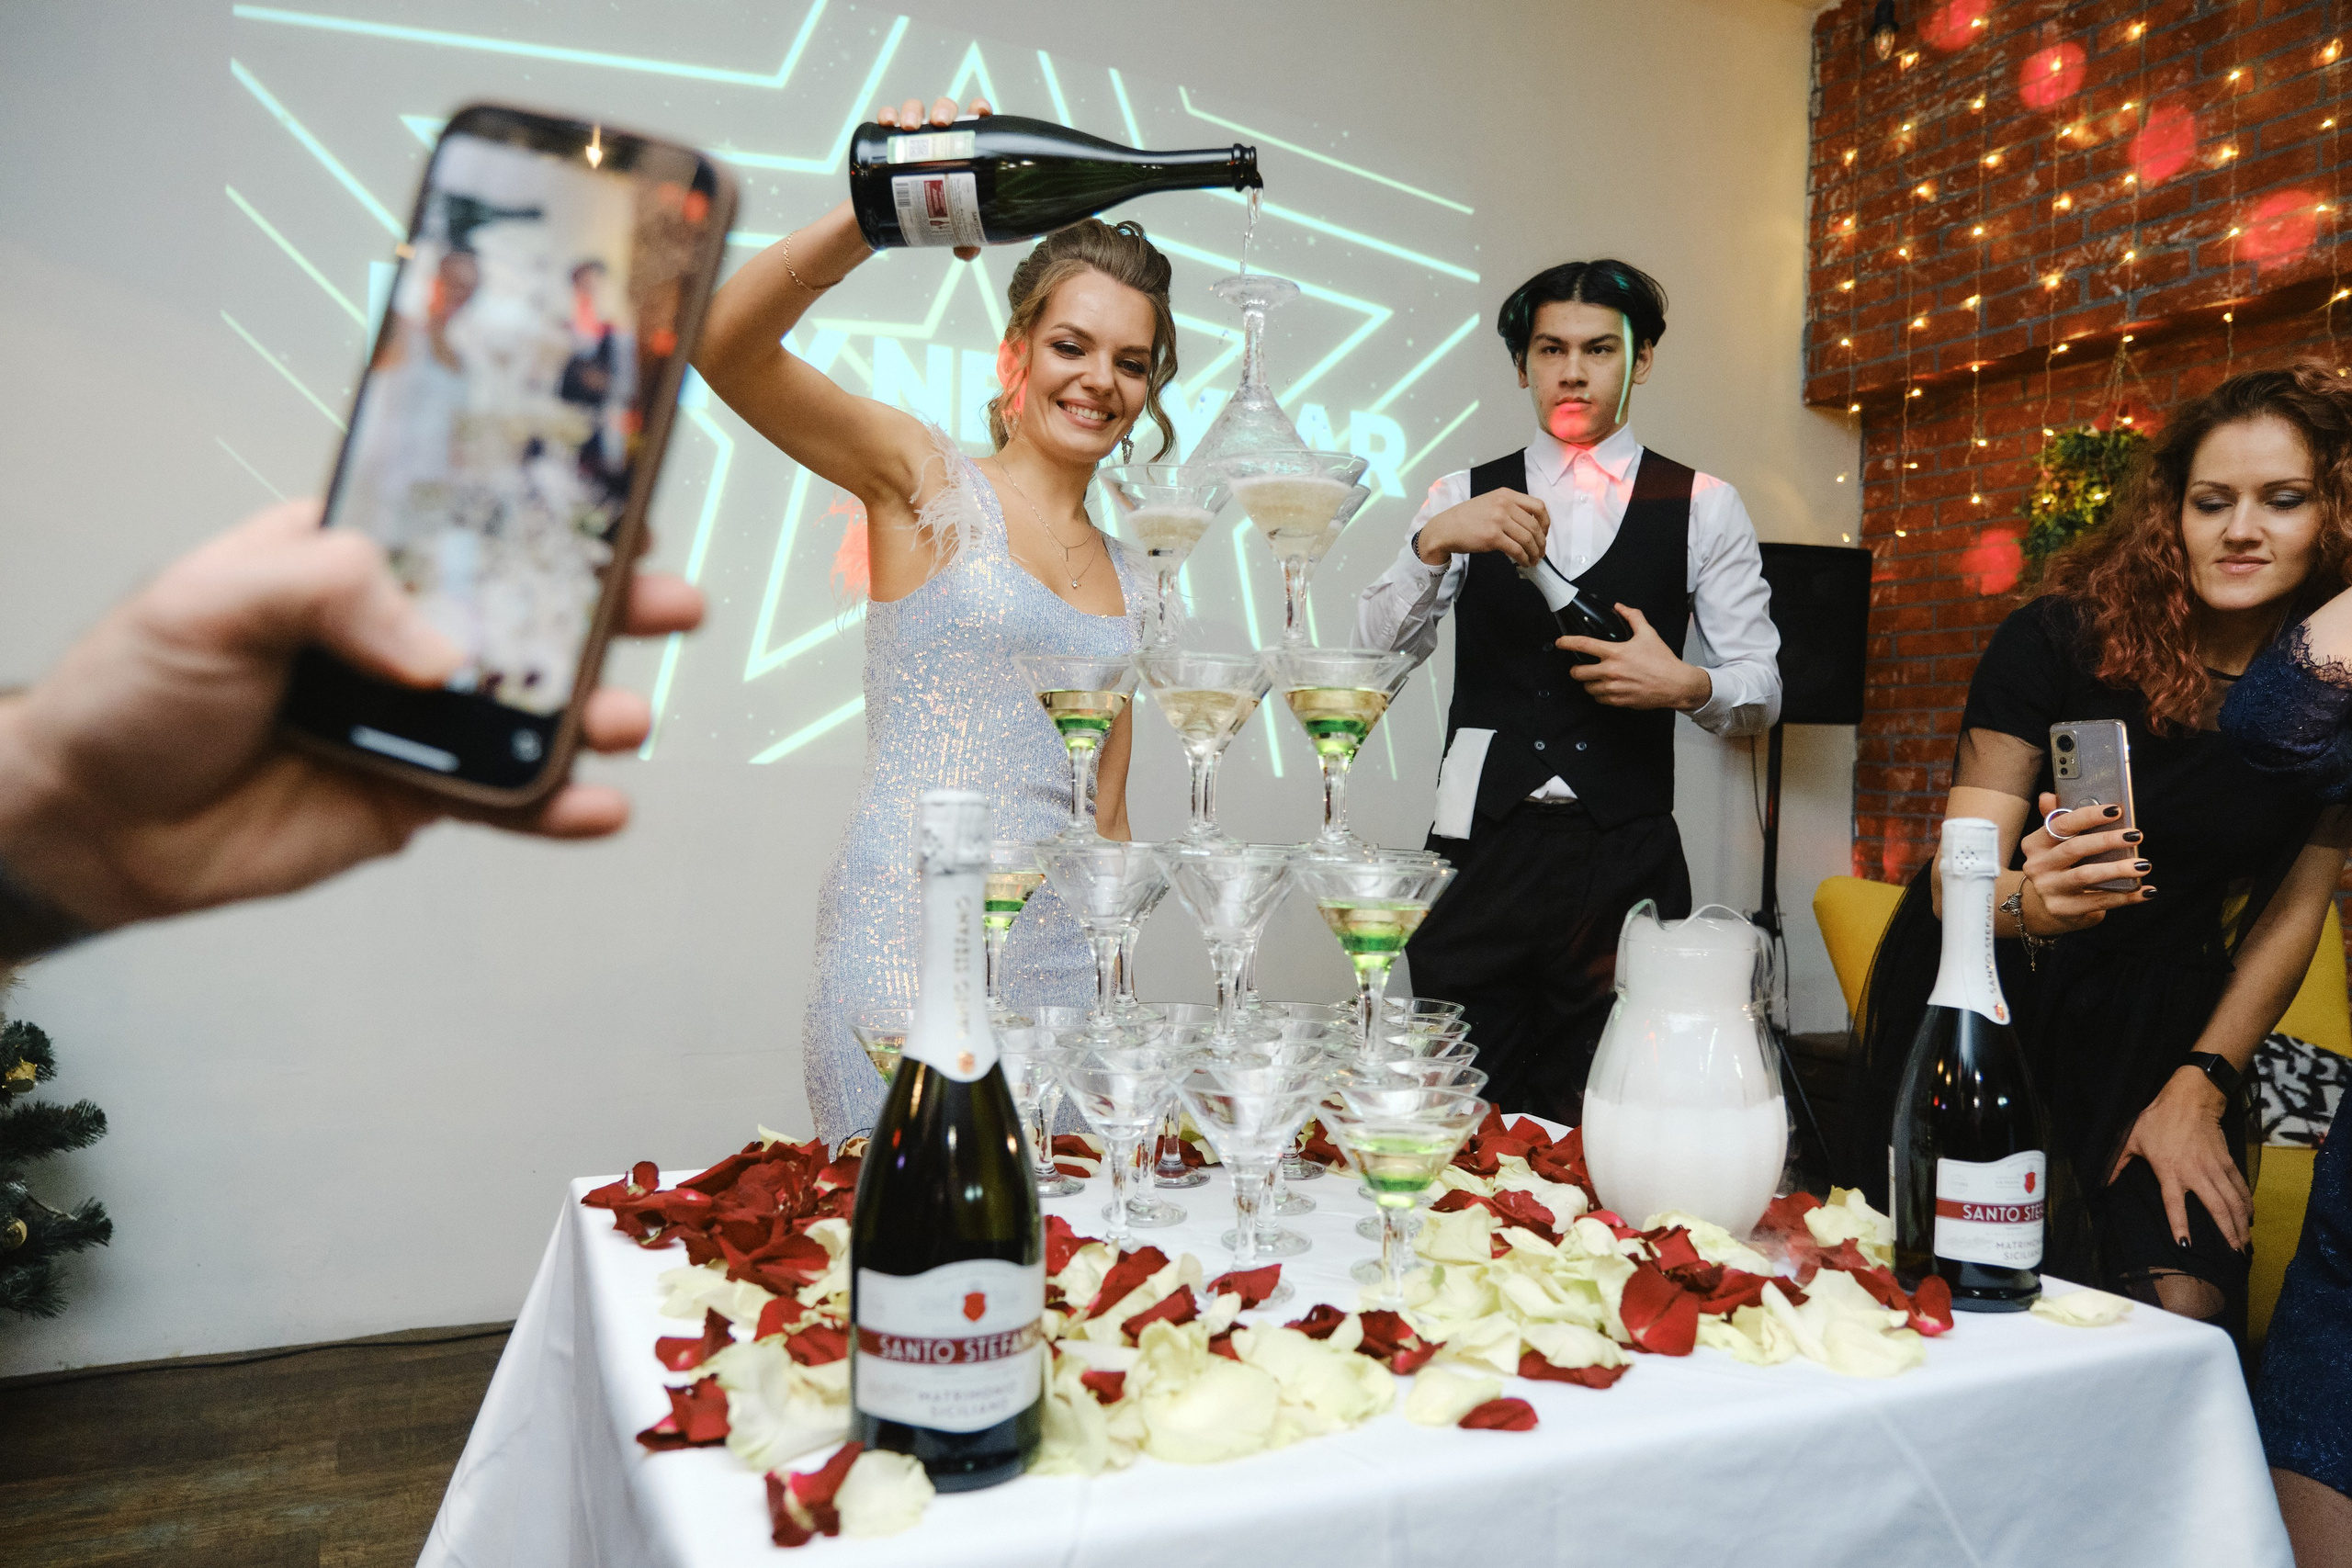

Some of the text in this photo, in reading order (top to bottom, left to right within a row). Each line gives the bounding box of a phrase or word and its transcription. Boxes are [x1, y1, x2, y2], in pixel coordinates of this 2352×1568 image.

[1159, 380, 1408, 499] YAR
[1962, 1204, 2020, 1223] SANTO
[878, 1335, 956, 1364] SANTO
